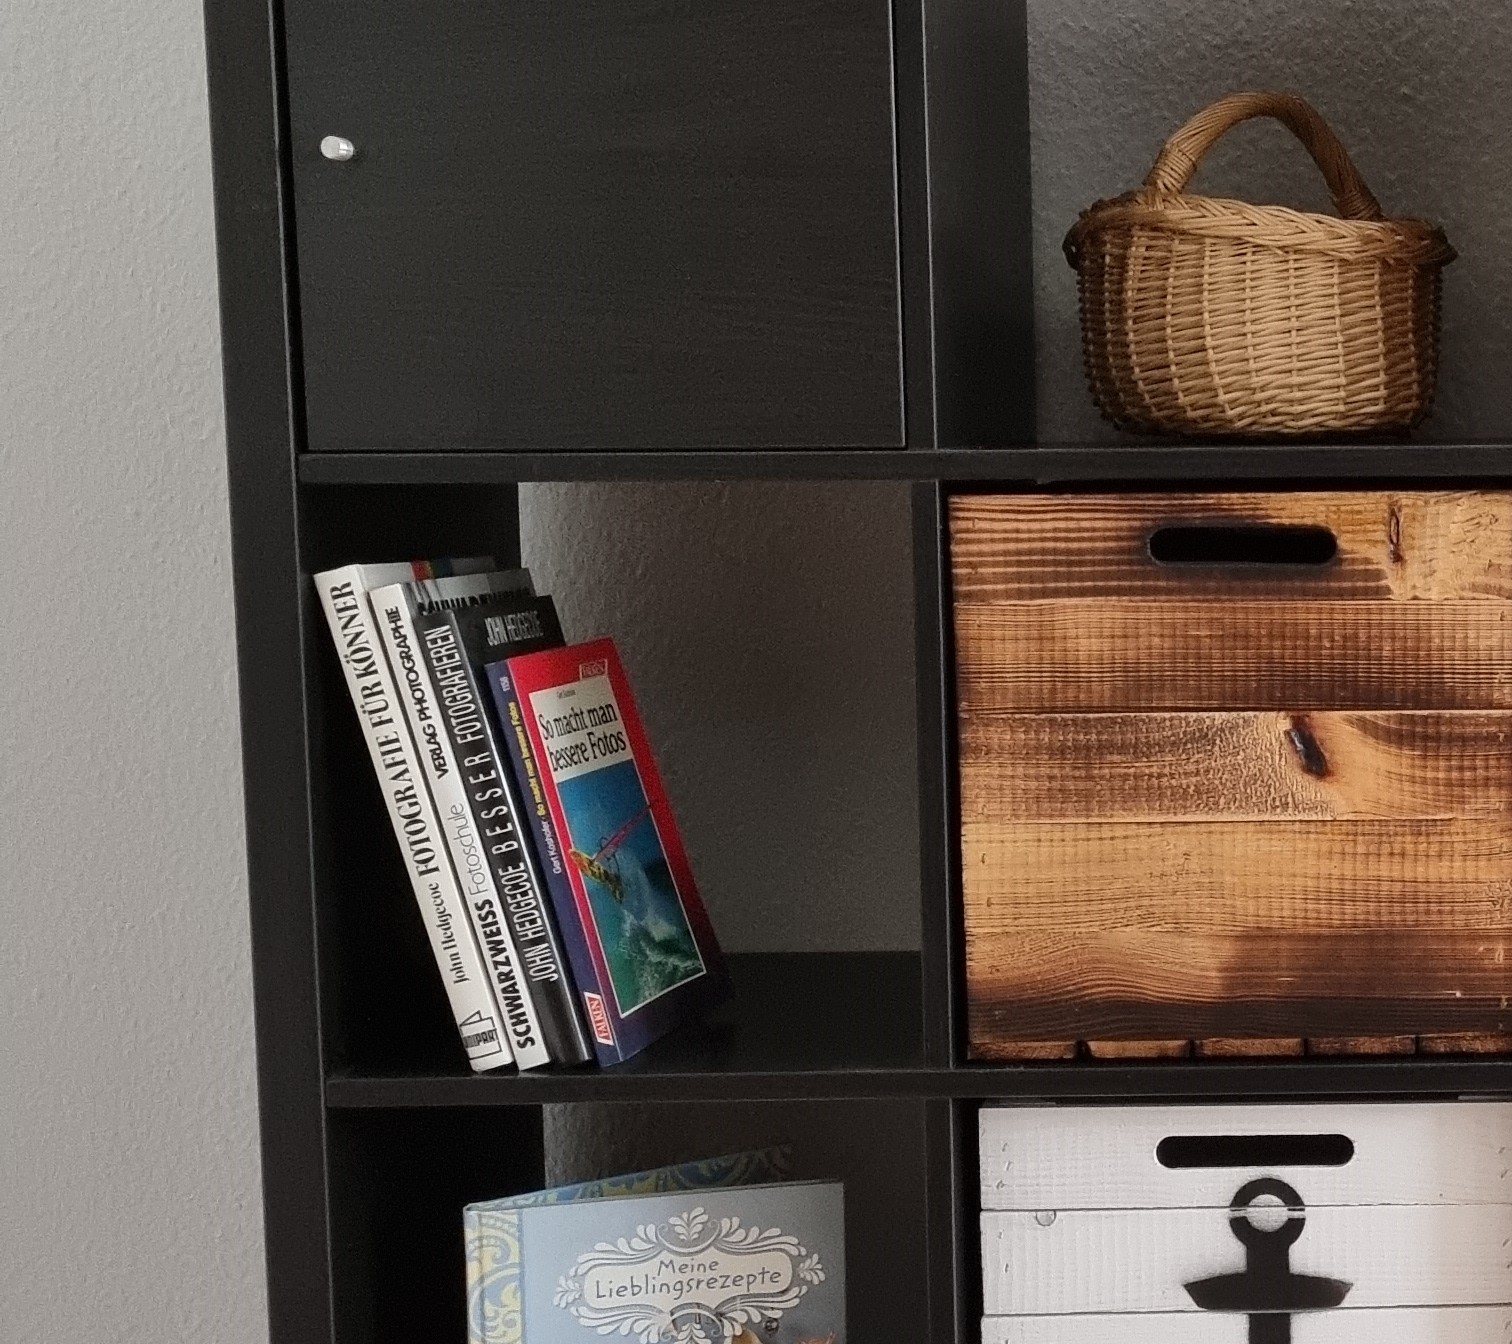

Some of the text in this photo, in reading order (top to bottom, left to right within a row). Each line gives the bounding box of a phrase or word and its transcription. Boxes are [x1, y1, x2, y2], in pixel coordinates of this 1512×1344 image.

[385, 606, 449, 779] VERLAG PHOTOGRAPHIE
[424, 624, 484, 744] FOTOGRAFIEREN
[538, 703, 618, 740] So macht man
[547, 730, 627, 772] bessere Fotos
[329, 581, 471, 984] John Hedgecoe FOTOGRAFIE FÜR KÖNNER
[464, 751, 519, 855] BESSER
[448, 802, 535, 1049] SCHWARZWEISS Fotoschule
[498, 862, 546, 941] HEDGECOE
[523, 942, 558, 982] JOHN
[589, 996, 610, 1041] FALKEN
[595, 1267, 782, 1300] Lieblingsrezepte
[657, 1258, 719, 1276] Meine
